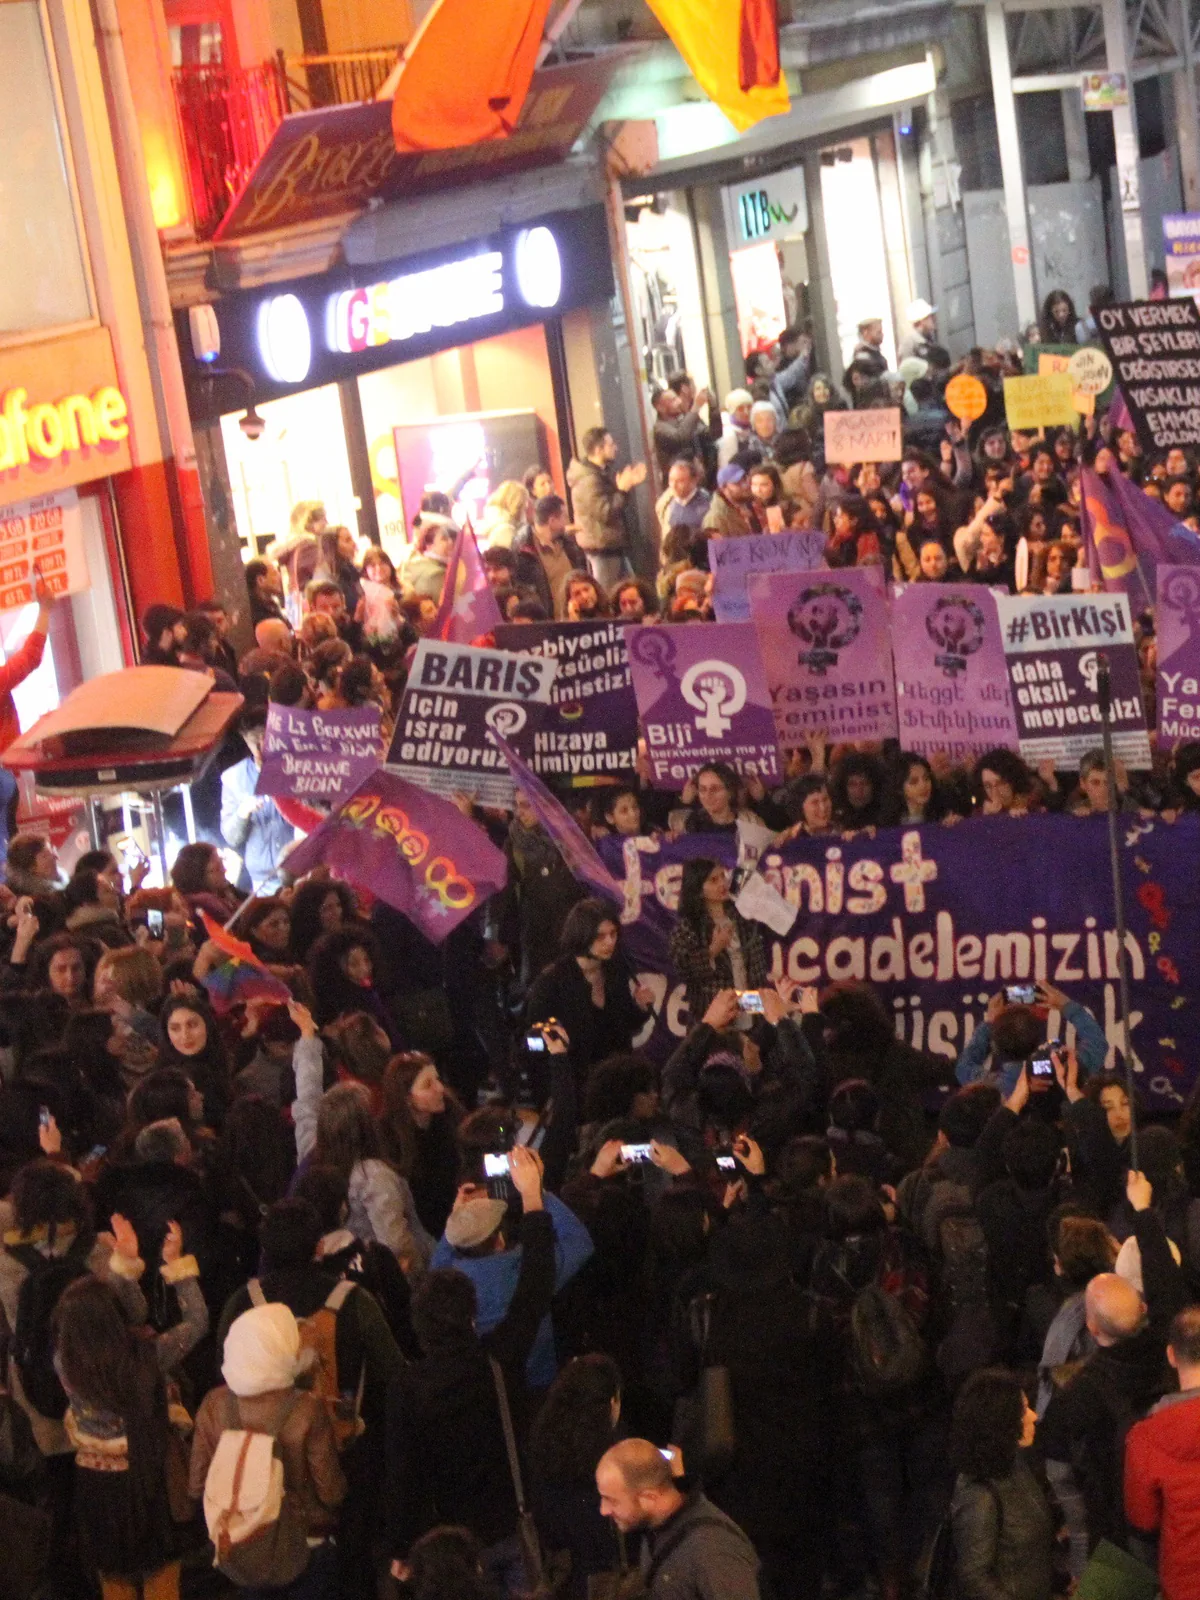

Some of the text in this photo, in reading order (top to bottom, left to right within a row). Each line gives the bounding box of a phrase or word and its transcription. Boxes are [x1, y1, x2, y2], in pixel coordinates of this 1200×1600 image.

[1100, 303, 1197, 331] OY VERMEK
[1006, 603, 1127, 643] #BirKişi
[420, 651, 543, 699] BARIŞ
[1011, 659, 1064, 684] daha
[768, 678, 886, 707] Yaşasın
[1017, 680, 1077, 706] eksil-
